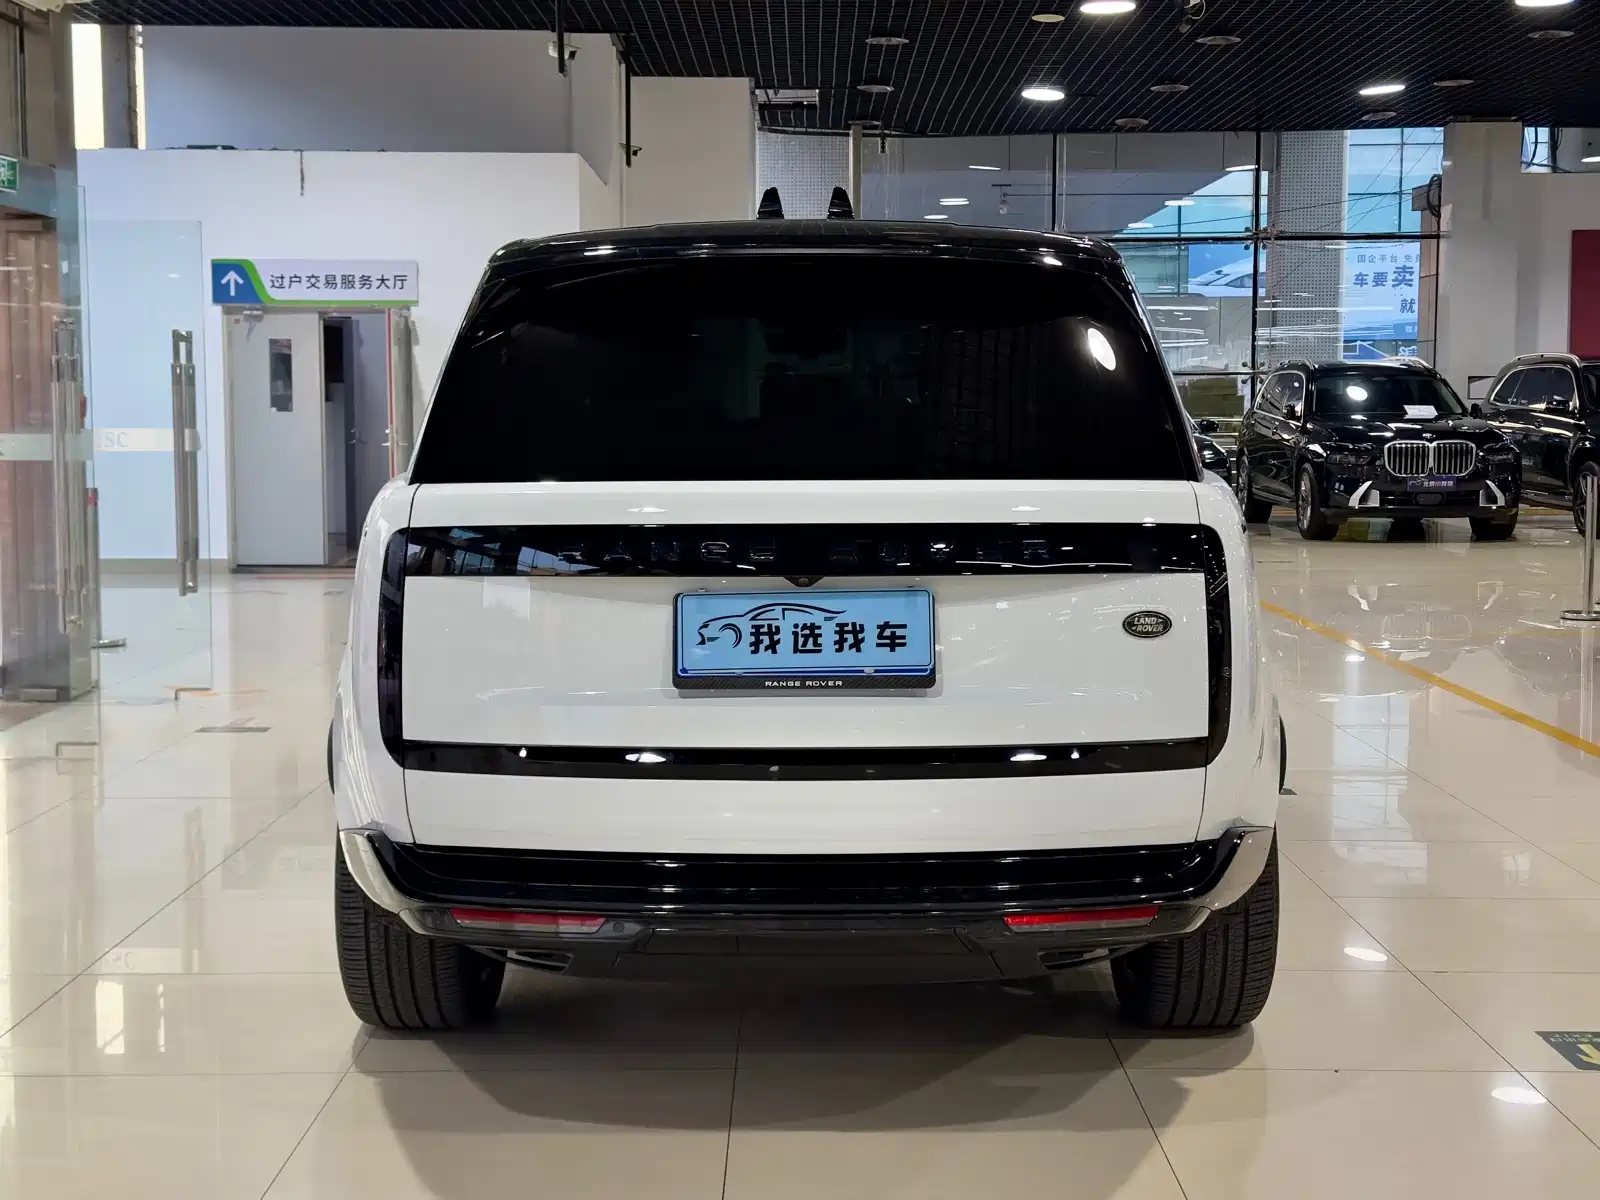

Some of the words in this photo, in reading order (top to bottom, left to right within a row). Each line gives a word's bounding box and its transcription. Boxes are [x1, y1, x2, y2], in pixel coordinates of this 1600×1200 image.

[1357, 254, 1398, 264] 国企平台
[269, 273, 409, 291] 过户交易服务大厅
[1353, 264, 1415, 288] 车要卖
[1399, 297, 1416, 314] 就
[1133, 617, 1157, 625] LAND
[1136, 624, 1164, 632] ROVER
[749, 621, 908, 655] 我选我车
